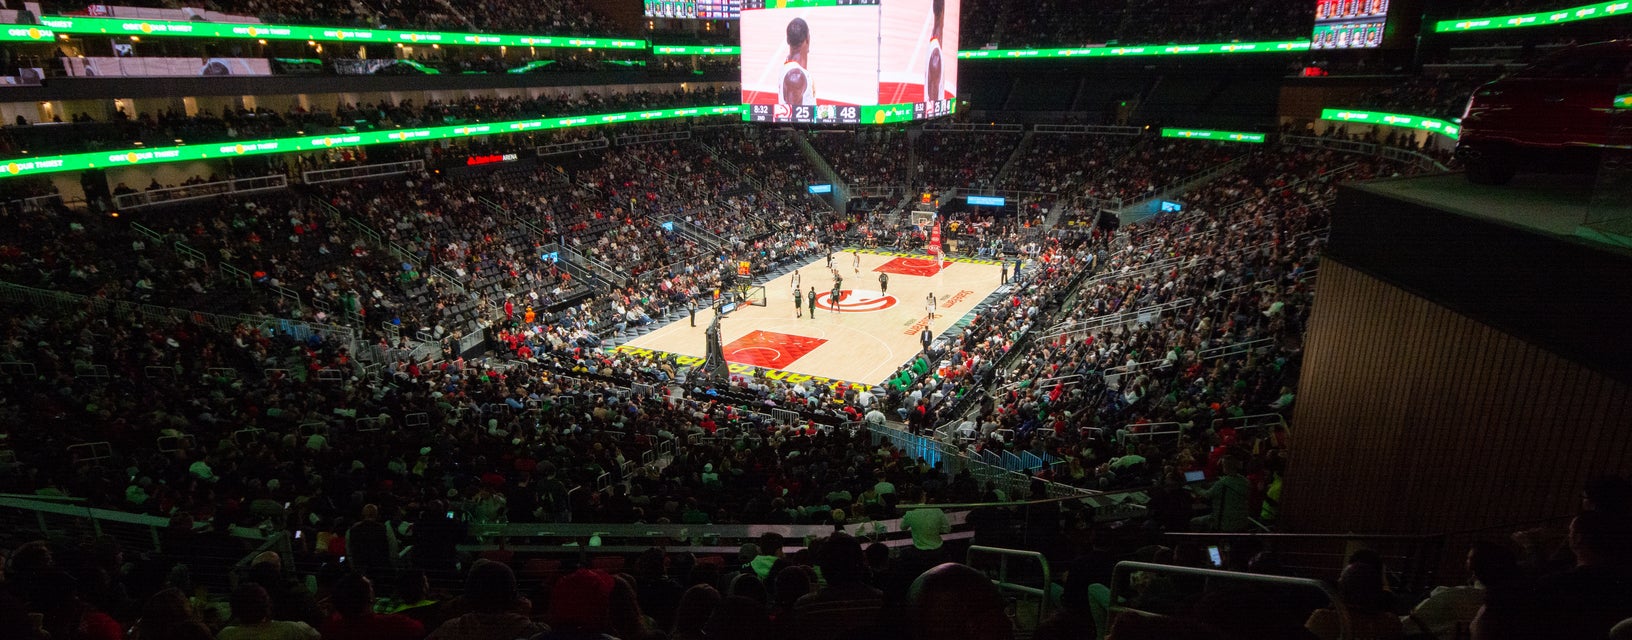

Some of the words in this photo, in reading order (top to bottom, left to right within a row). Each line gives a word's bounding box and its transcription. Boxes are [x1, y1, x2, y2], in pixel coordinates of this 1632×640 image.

[753, 104, 769, 114] 8:32
[795, 106, 810, 119] 25
[840, 106, 856, 119] 48
